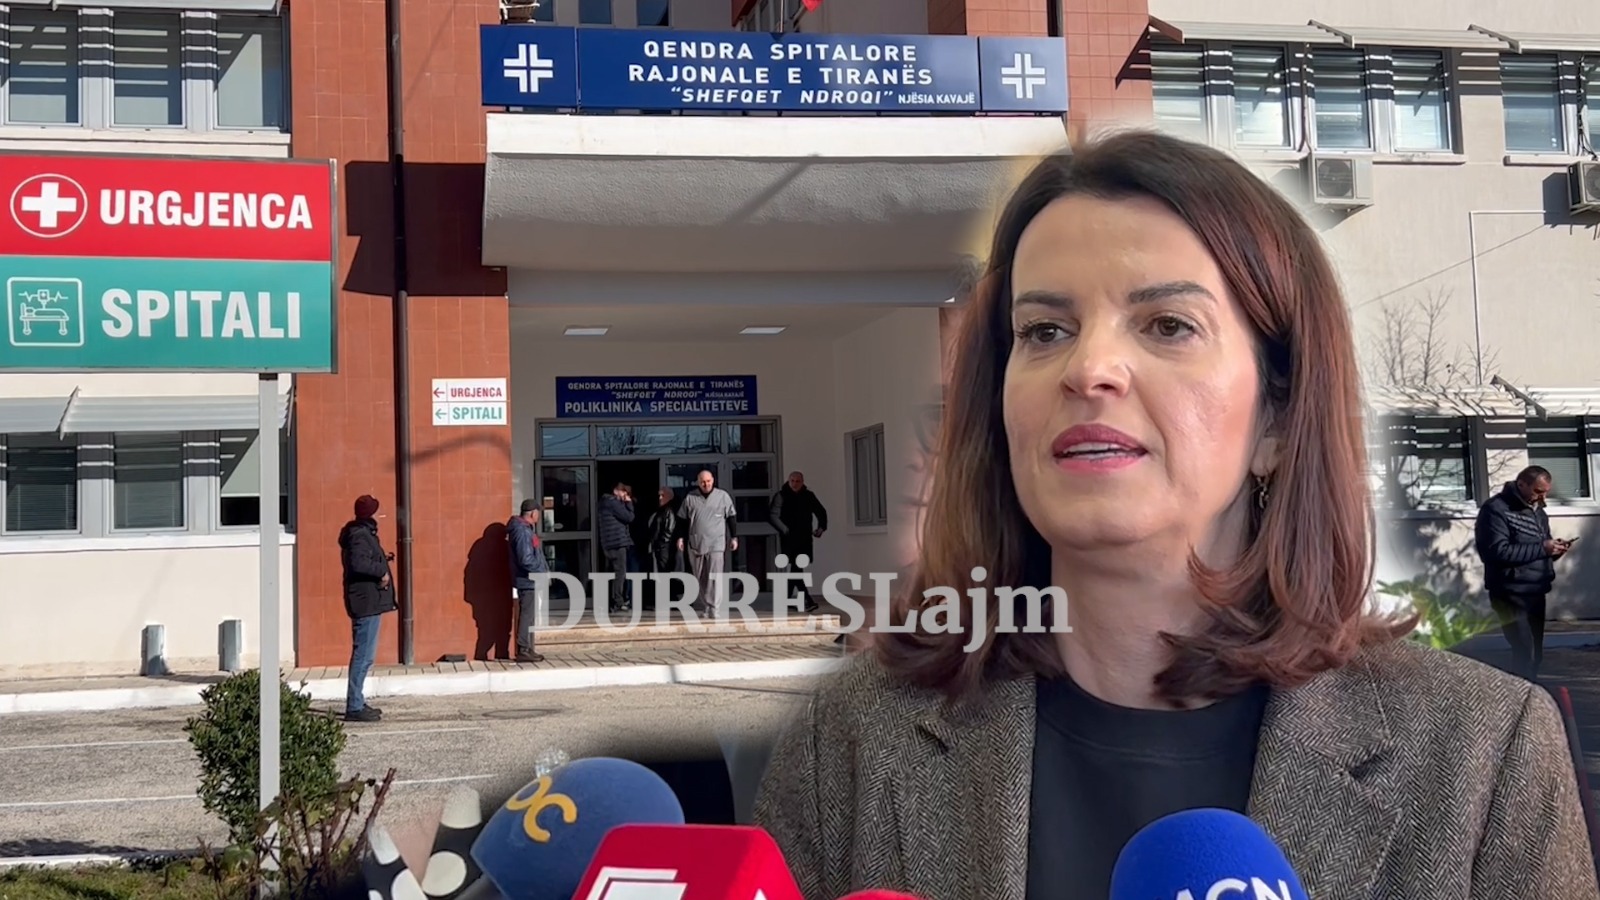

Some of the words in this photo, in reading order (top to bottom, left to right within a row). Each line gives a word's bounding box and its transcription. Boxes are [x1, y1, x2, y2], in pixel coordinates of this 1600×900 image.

[643, 41, 752, 59] QENDRA
[770, 43, 917, 62] SPITALORE
[628, 64, 770, 84] RAJONALE
[788, 67, 802, 84] E
[819, 65, 933, 86] TIRANËS
[898, 94, 935, 105] NJËSIA
[936, 93, 976, 105] KAVAJË
[100, 188, 313, 230] URGJENCA
[101, 288, 301, 339] SPITALI
[604, 382, 650, 390] SPITALORE
[652, 381, 695, 390] RAJONALE
[710, 380, 745, 389] TIRANËS
[451, 388, 502, 397] URGJENCA
[453, 407, 502, 419] SPITALI
[564, 401, 642, 413] POLIKLINIKA
[650, 400, 749, 412] SPECIALITETEVE
